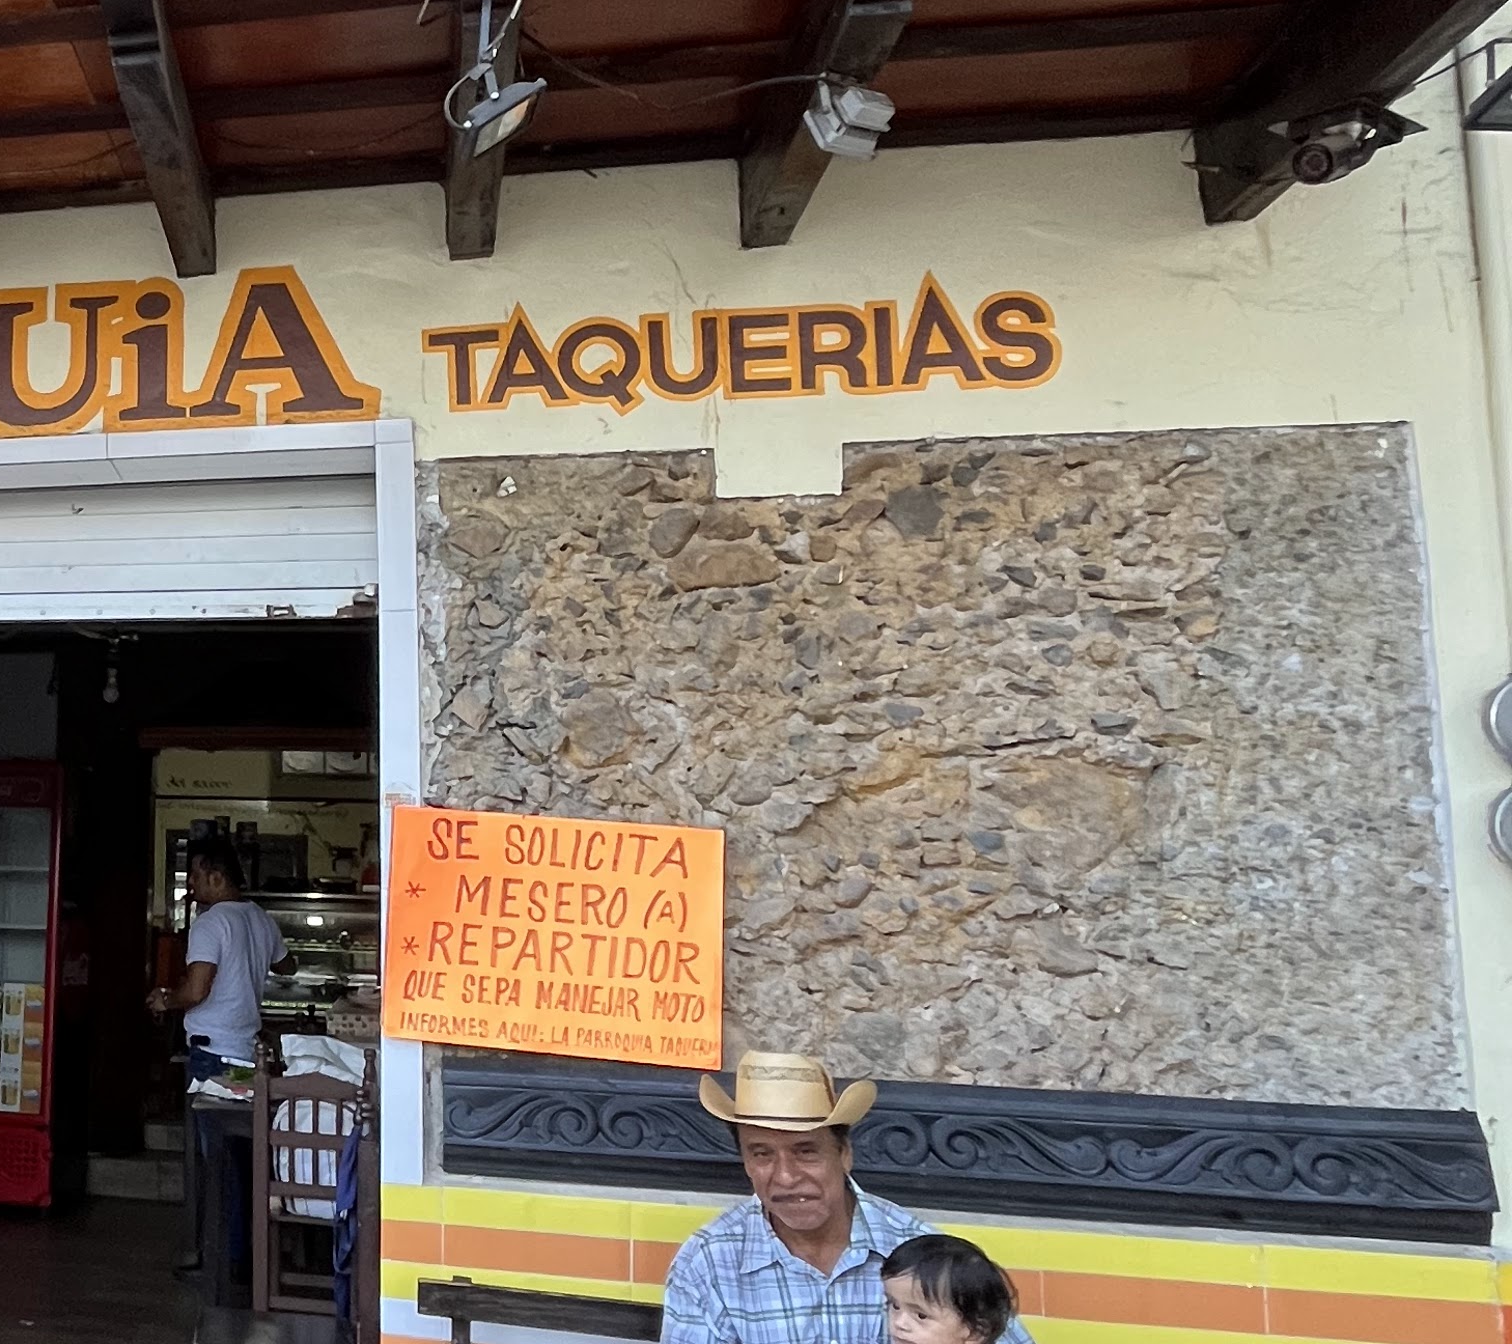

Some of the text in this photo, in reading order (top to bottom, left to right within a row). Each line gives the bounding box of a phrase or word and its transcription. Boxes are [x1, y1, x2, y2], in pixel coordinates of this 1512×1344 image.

[422, 270, 1062, 416] TAQUERIAS
[426, 817, 689, 879] SE SOLICITA
[454, 874, 689, 933] MESERO (A)
[427, 921, 701, 985] REPARTIDOR
[402, 969, 706, 1024] QUE SEPA MANEJAR MOTO
[399, 1011, 489, 1039] INFORMES
[551, 1026, 570, 1047] LA
[576, 1027, 653, 1054] PARROQUIA
